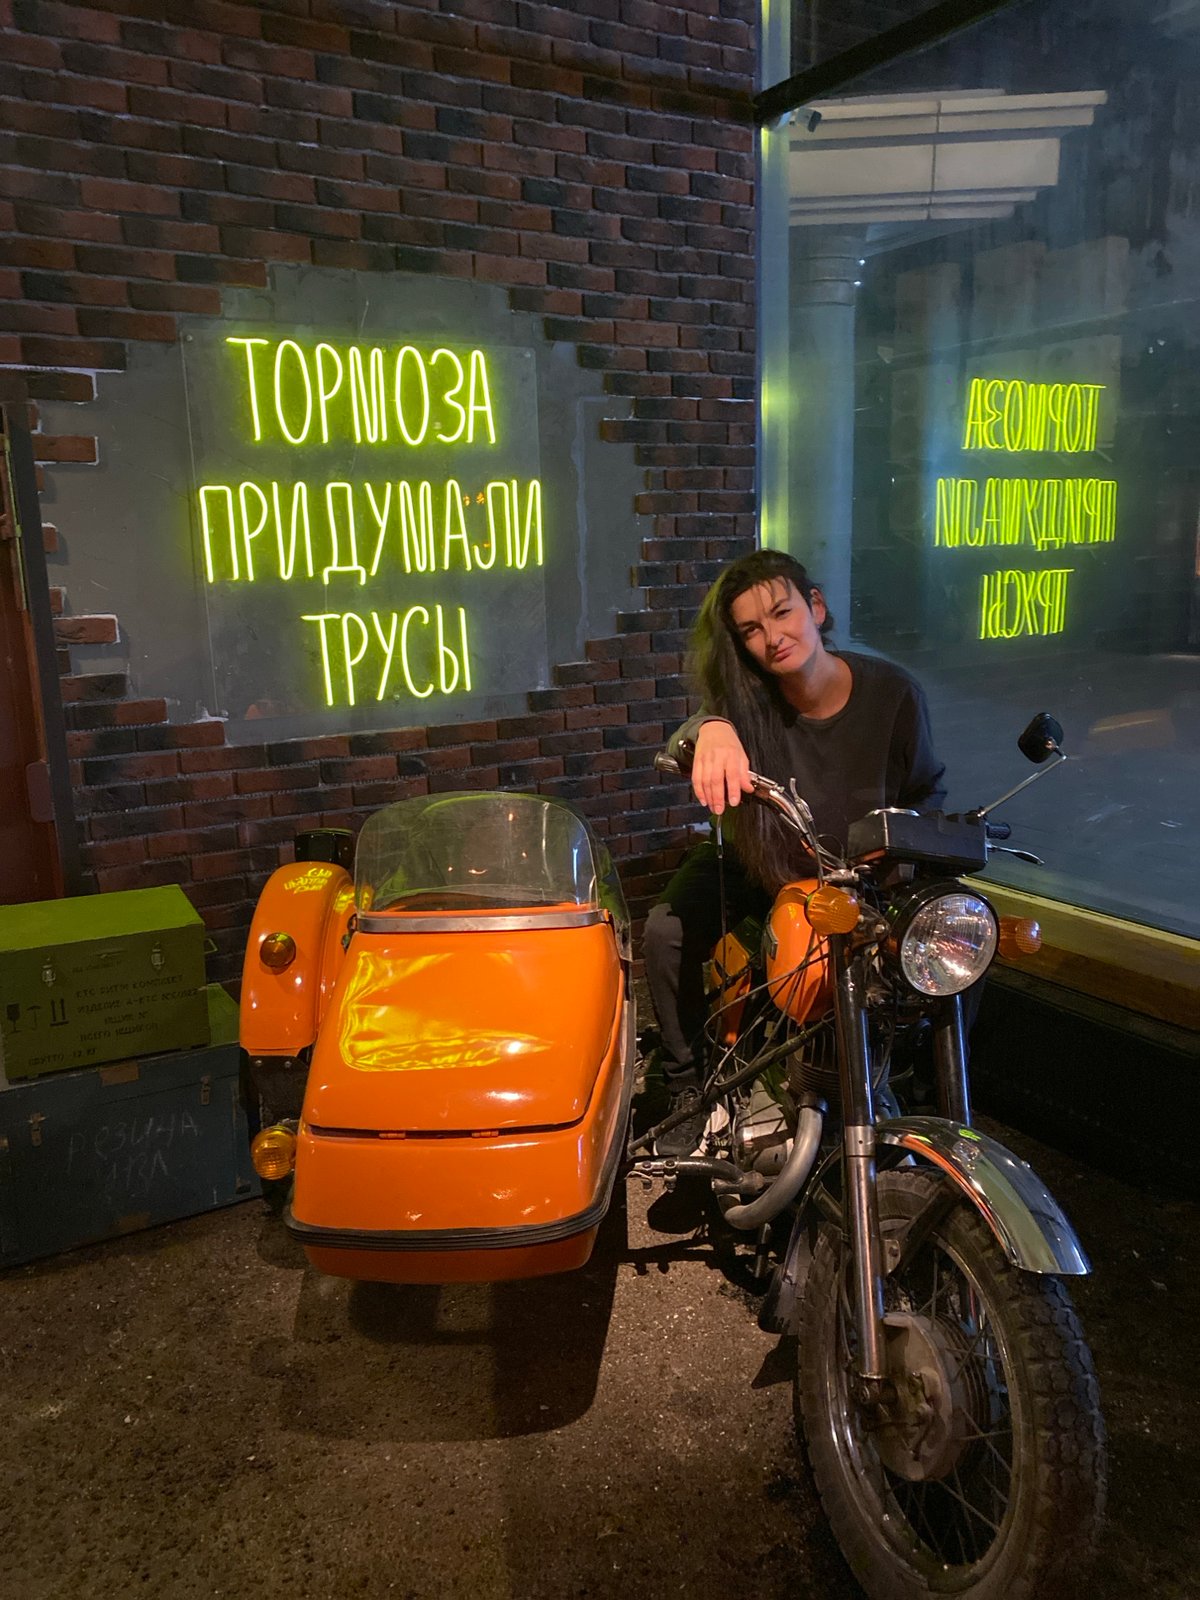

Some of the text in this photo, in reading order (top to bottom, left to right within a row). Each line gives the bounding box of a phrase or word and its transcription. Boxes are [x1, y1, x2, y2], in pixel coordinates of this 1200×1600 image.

[226, 337, 496, 445] ТОРМОЗА
[199, 479, 544, 586] ПРИДУМАЛИ
[301, 604, 472, 707] ТРУСЫ
